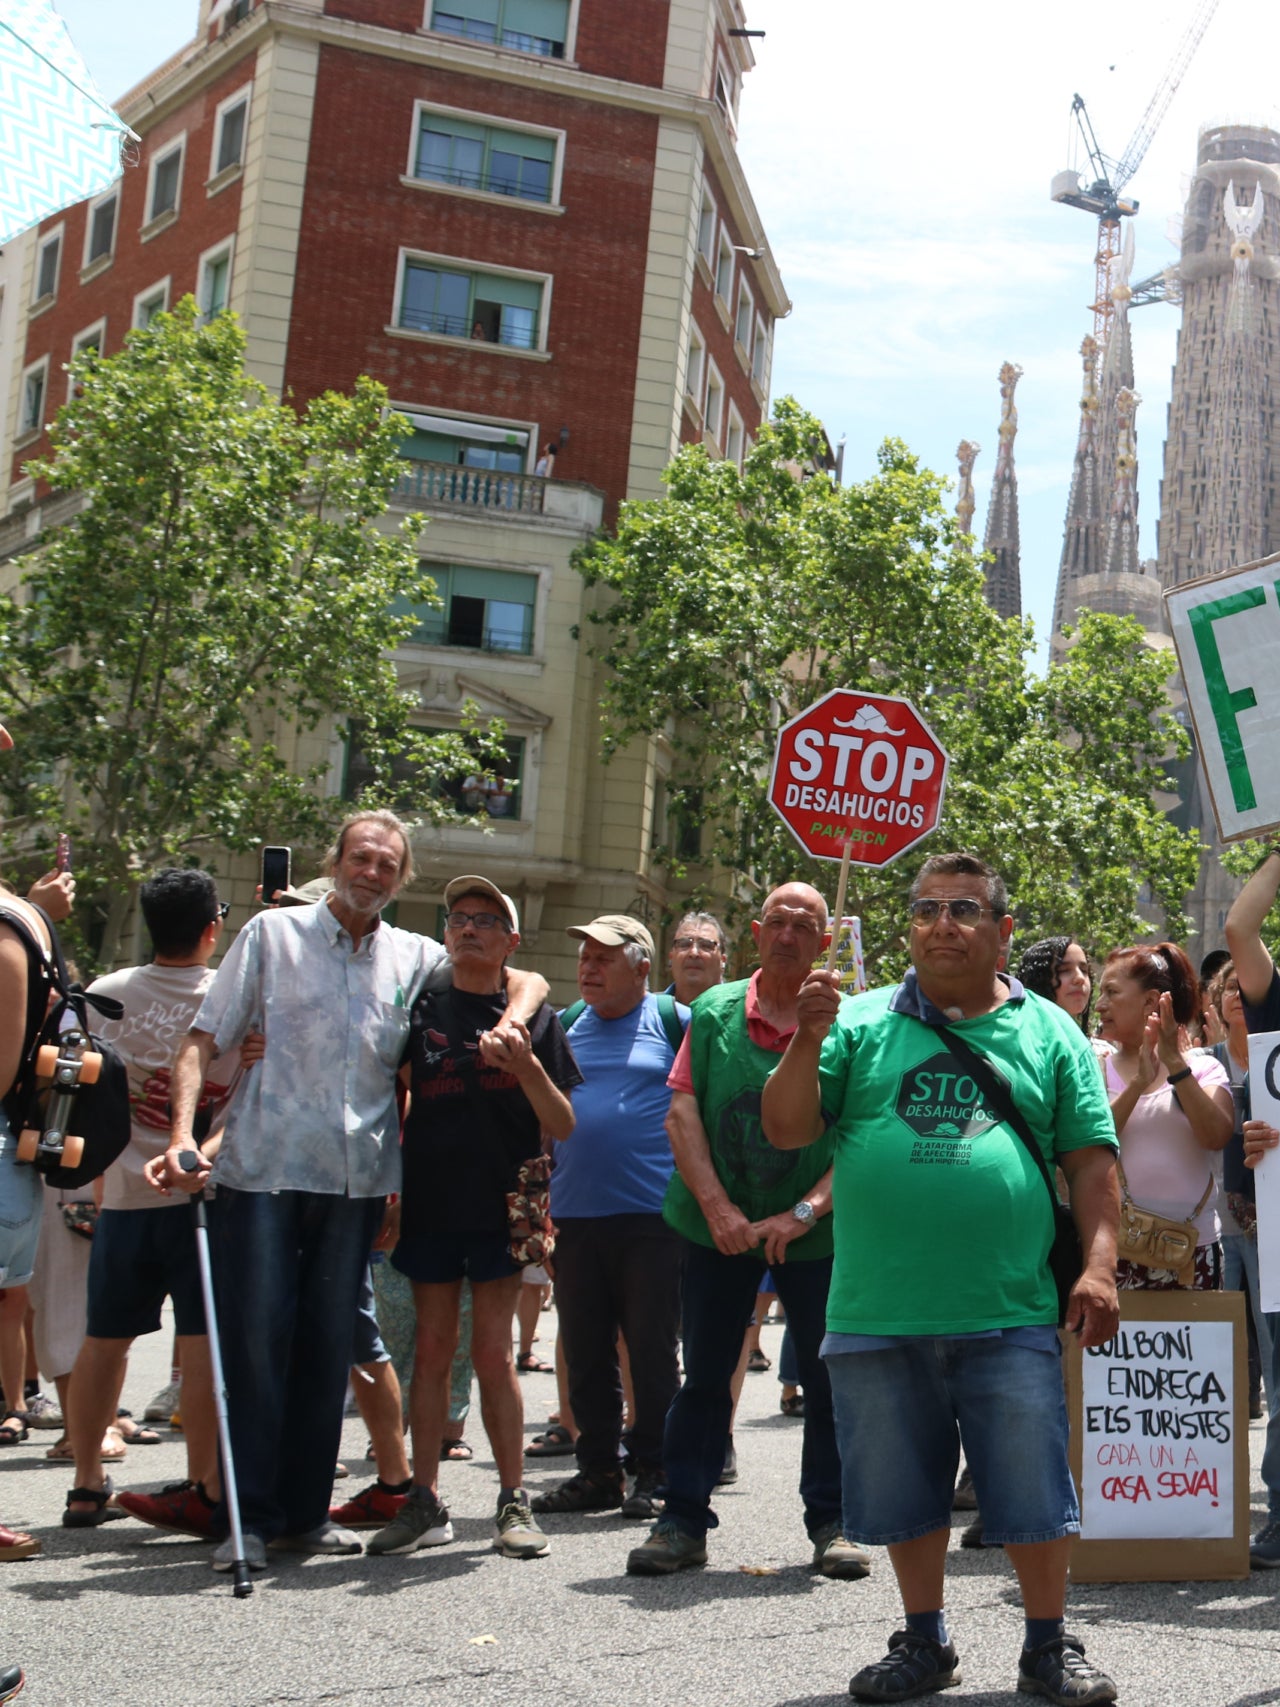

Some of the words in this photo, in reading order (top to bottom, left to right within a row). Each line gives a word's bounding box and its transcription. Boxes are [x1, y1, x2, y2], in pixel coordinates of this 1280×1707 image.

[789, 728, 935, 798] STOP
[784, 784, 925, 828] DESAHUCIOS
[810, 822, 846, 839] PAH
[850, 829, 888, 846] BCN
[910, 1072, 985, 1105] STO
[905, 1105, 995, 1121] DESAHUCIOS
[913, 1142, 972, 1151] PLATAFORMA
[924, 1150, 972, 1159] AFECTADOS
[1108, 1367, 1225, 1406] ENDREÇA
[1086, 1406, 1131, 1434] ELS
[1135, 1406, 1231, 1443] TURISTES
[1097, 1443, 1141, 1467] CADA
[1150, 1445, 1174, 1468] UN
[1184, 1447, 1199, 1469] A
[1101, 1475, 1151, 1503] CASA
[1157, 1467, 1219, 1507] SEVA!
